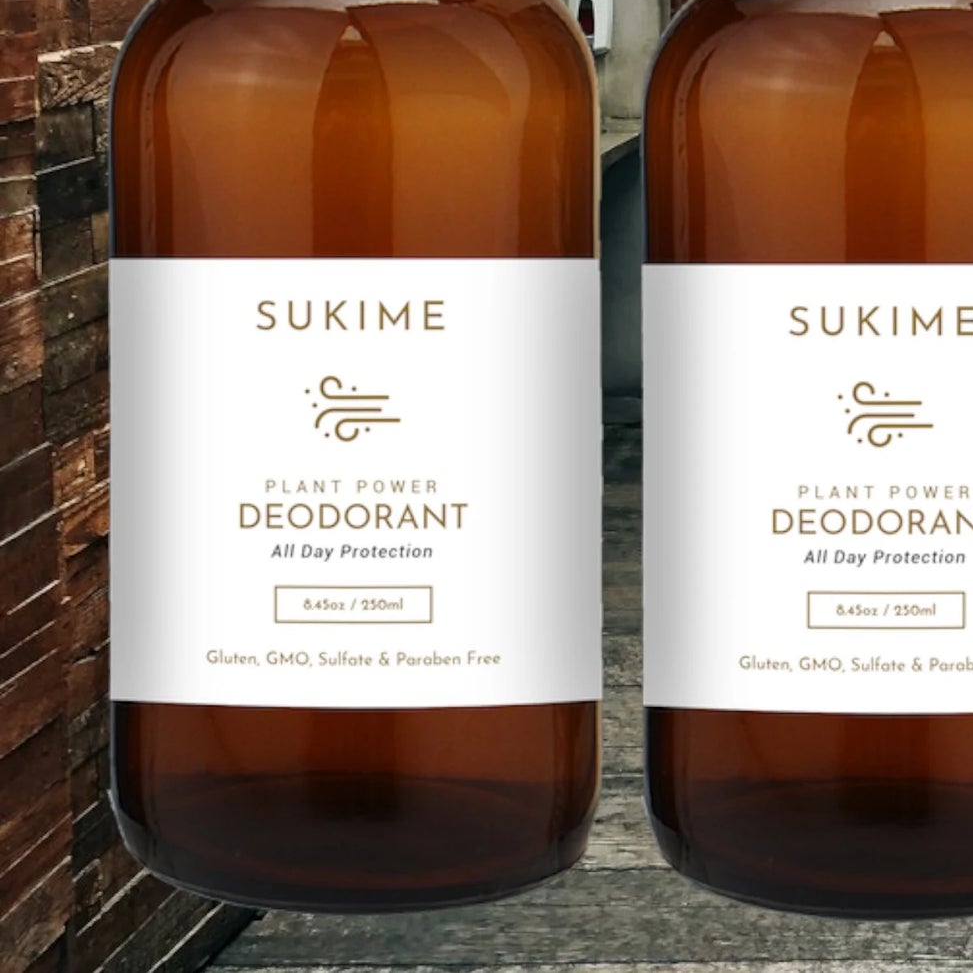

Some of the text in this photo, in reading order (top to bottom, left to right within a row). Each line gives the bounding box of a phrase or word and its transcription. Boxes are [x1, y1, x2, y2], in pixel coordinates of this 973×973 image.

[256, 300, 445, 331] SUKIME
[265, 479, 436, 494] PLANT POWER
[798, 484, 969, 500] PLANT POWER
[239, 502, 469, 530] DEODORANT
[271, 543, 433, 562] All Day Protection
[803, 549, 965, 568] All Day Protection
[303, 598, 345, 611] 8.45oz
[360, 597, 403, 611] 250ml
[836, 604, 878, 616] 8.45oz
[893, 603, 936, 616] 250ml
[206, 649, 501, 667] Gluten, GMO, Sulfate & Paraben Free
[739, 655, 792, 672] Gluten,
[799, 656, 845, 673] GMO,
[851, 656, 905, 672] Sulfate
[911, 657, 922, 672] &
